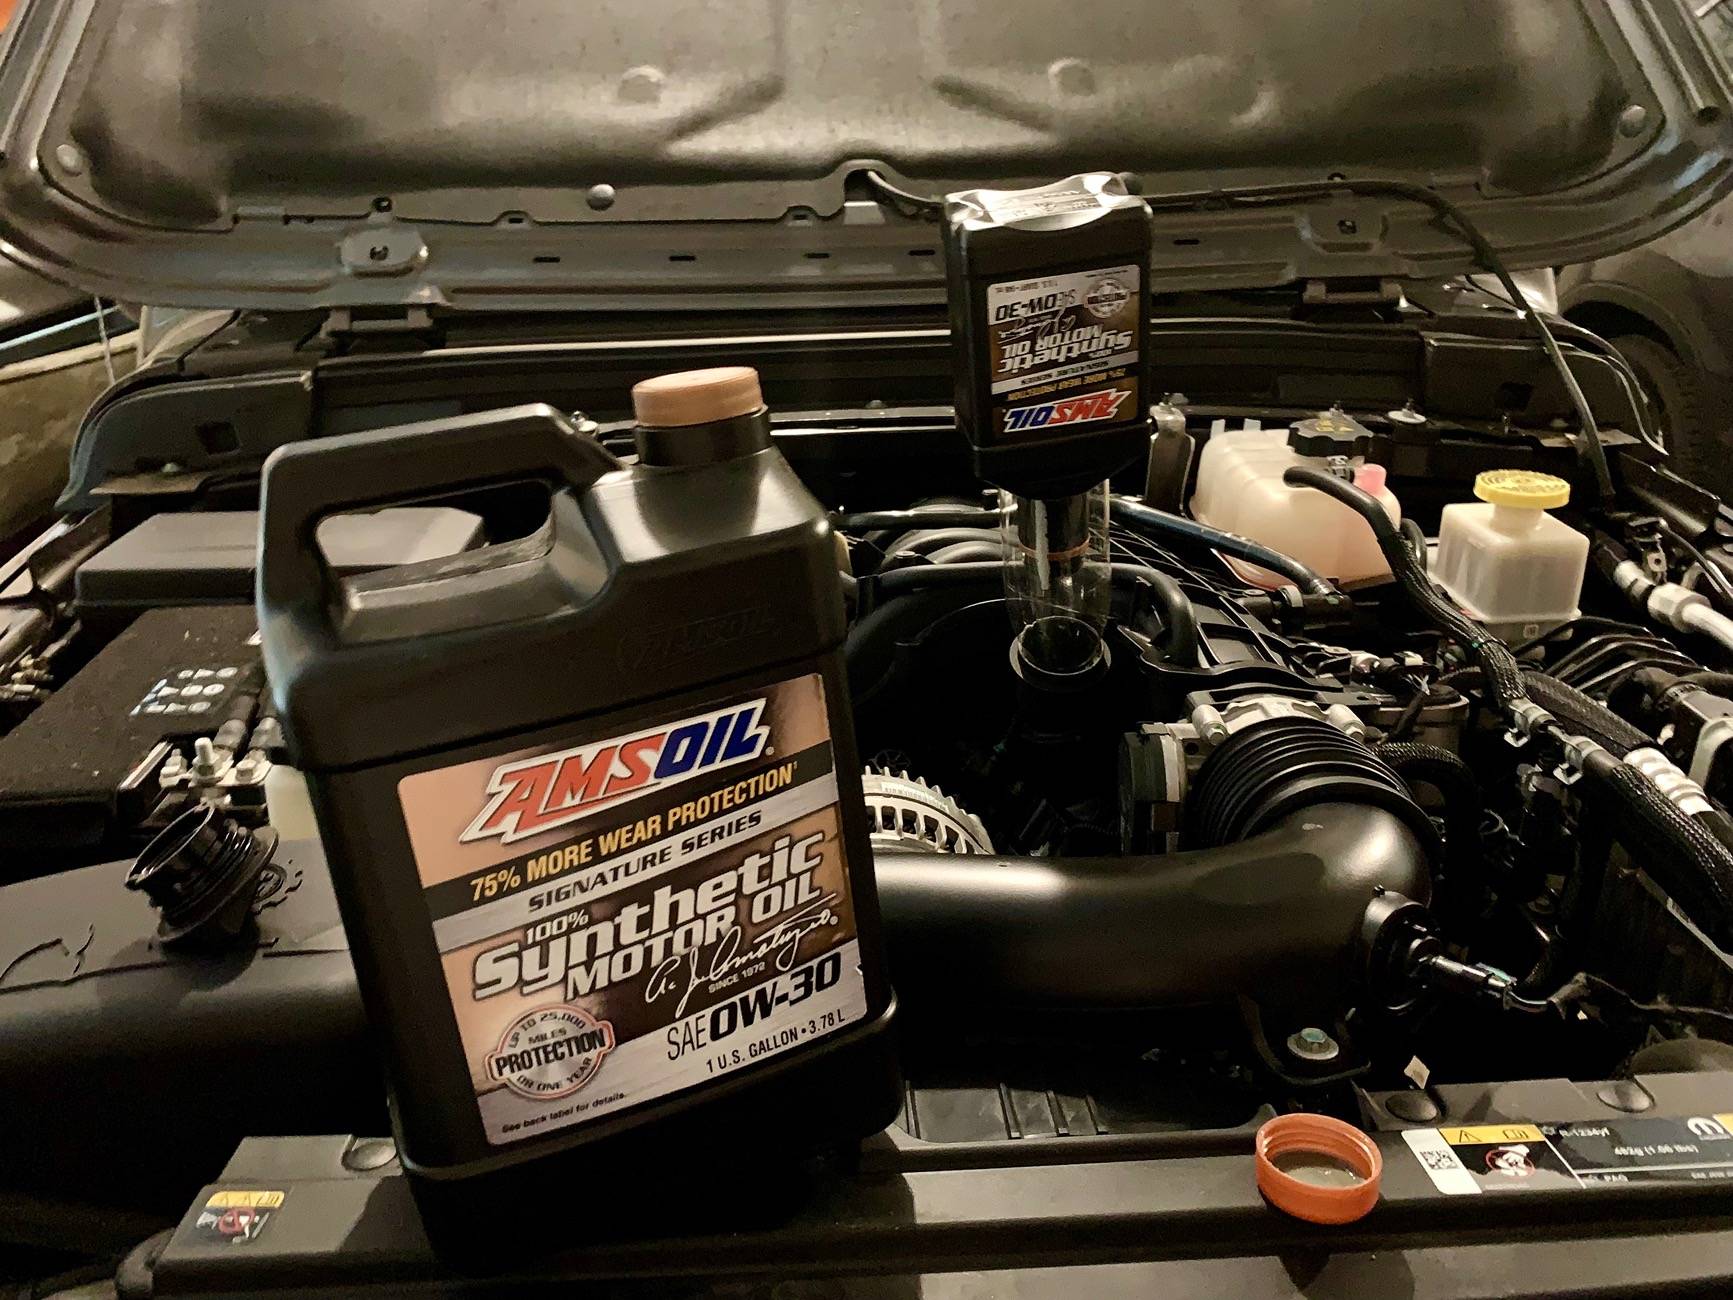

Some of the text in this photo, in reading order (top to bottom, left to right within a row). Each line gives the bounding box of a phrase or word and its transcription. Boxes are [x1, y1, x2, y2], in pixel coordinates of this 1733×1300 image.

[995, 294, 1057, 321] 0W-30
[997, 329, 1134, 374] Synthetic
[1001, 341, 1031, 359] OIL
[1035, 324, 1103, 350] MOTOR
[1004, 388, 1132, 433] AMSOIL
[461, 698, 770, 843] AMSOIL
[470, 866, 521, 900] 75%
[527, 839, 593, 882] MORE
[599, 815, 661, 856] WEAR
[528, 810, 761, 912] SIGNATURE SERIES
[475, 832, 824, 1000] Synthetic
[526, 909, 589, 944] 100%
[565, 871, 821, 1001] MOTOR OIL
[708, 961, 766, 993] SINCE 1972
[521, 1018, 537, 1032] TO
[540, 1011, 587, 1030] 25,000
[667, 951, 841, 1061] SAE 0W-30
[494, 1028, 606, 1077] PROTECTION
[528, 1027, 567, 1045] MILES
[706, 1008, 846, 1073] 1 U.S. GALLON 3.78 L
[516, 1056, 593, 1092] OR ONE YEAR
[523, 1115, 547, 1127] back
[576, 1101, 589, 1113] for
